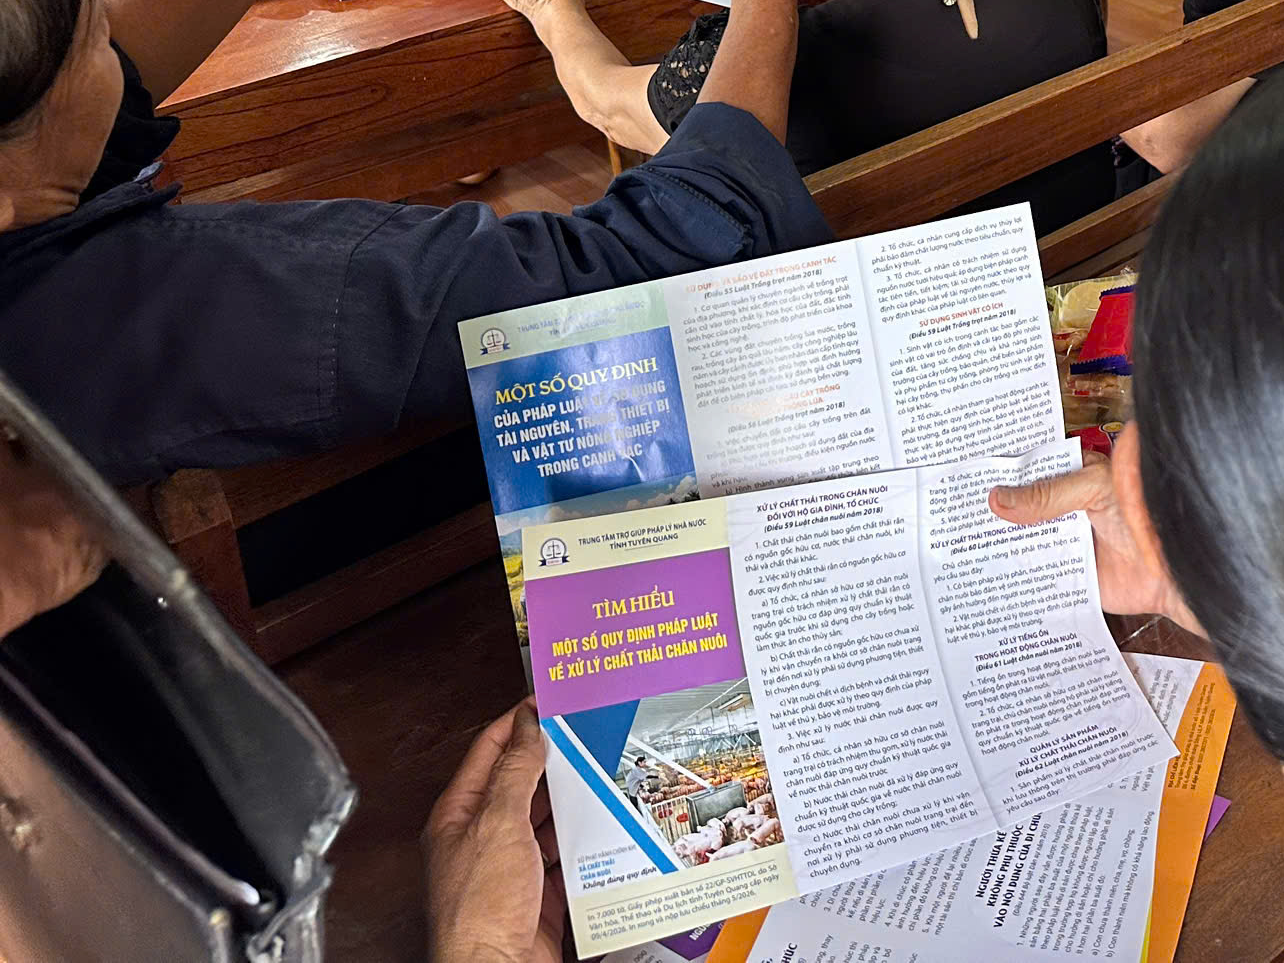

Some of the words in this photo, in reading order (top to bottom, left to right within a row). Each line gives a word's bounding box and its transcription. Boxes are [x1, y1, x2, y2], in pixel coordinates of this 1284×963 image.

[951, 311, 968, 320] SINH
[495, 382, 536, 406] MỘT
[539, 372, 565, 395] SỐ
[568, 369, 609, 392] QUY
[611, 356, 659, 380] ĐỊNH
[494, 408, 521, 428] CỦA
[523, 402, 557, 421] PHÁP
[496, 430, 517, 447] TÀI
[519, 420, 574, 444] NGUYÊN,
[656, 397, 671, 413] BỊ
[512, 447, 530, 464] VÀ
[532, 441, 555, 460] VẬT
[558, 438, 575, 453] TƯ
[537, 457, 580, 477] TRONG
[582, 449, 617, 468] CANH
[757, 503, 770, 513] XỬ
[769, 502, 779, 512] LÝ
[779, 498, 800, 509] CHẤT
[800, 496, 819, 507] THẢI
[819, 492, 845, 504] TRONG
[846, 487, 868, 499] CHĂN
[868, 485, 888, 495] NUÔI
[767, 511, 782, 522] ĐỐI
[782, 509, 796, 520] VỚI
[797, 506, 809, 518] HỘ
[809, 504, 824, 515] GIA
[824, 501, 846, 513] ĐÌNH,
[846, 498, 858, 509] TỔ
[857, 496, 880, 508] CHỨC
[578, 535, 601, 546] TRUNG
[601, 531, 616, 543] TÂM
[616, 529, 631, 541] TRỢ
[630, 526, 647, 538] GIÚP
[647, 525, 666, 536] PHÁP
[665, 523, 673, 533] LÝ
[673, 520, 688, 531] NHÀ
[688, 518, 707, 529] NƯỚC
[609, 539, 627, 550] TỈNH
[628, 536, 652, 548] TUYÊN
[652, 532, 679, 545] QUANG
[592, 597, 627, 620] TÌM
[629, 585, 675, 613] HIỂU
[552, 637, 579, 658] MỘT
[582, 629, 598, 651] SỐ
[600, 629, 625, 650] QUY
[626, 624, 656, 646] ĐỊNH
[657, 618, 689, 637] PHÁP
[691, 611, 719, 631] LUẬT
[548, 661, 565, 682] VỀ
[567, 657, 588, 679] XỬ
[587, 654, 602, 676] LÝ
[603, 647, 634, 671] CHẤT
[636, 643, 664, 665] THẢI
[666, 638, 698, 659] CHĂN
[699, 633, 729, 653] NUÔI
[1006, 823, 1024, 853] THUỘC
[976, 868, 994, 898] NGƯỜI
[987, 844, 1003, 867] THỪA
[996, 830, 1008, 843] KẾ
[1000, 855, 1013, 873] PHỤ
[987, 873, 1006, 907] KHÔNG
[993, 908, 1008, 928] VÀO
[1001, 889, 1015, 907] NỘI
[1008, 862, 1024, 888] DUNG
[1018, 843, 1032, 861] CỦA
[1025, 833, 1035, 843] DI
